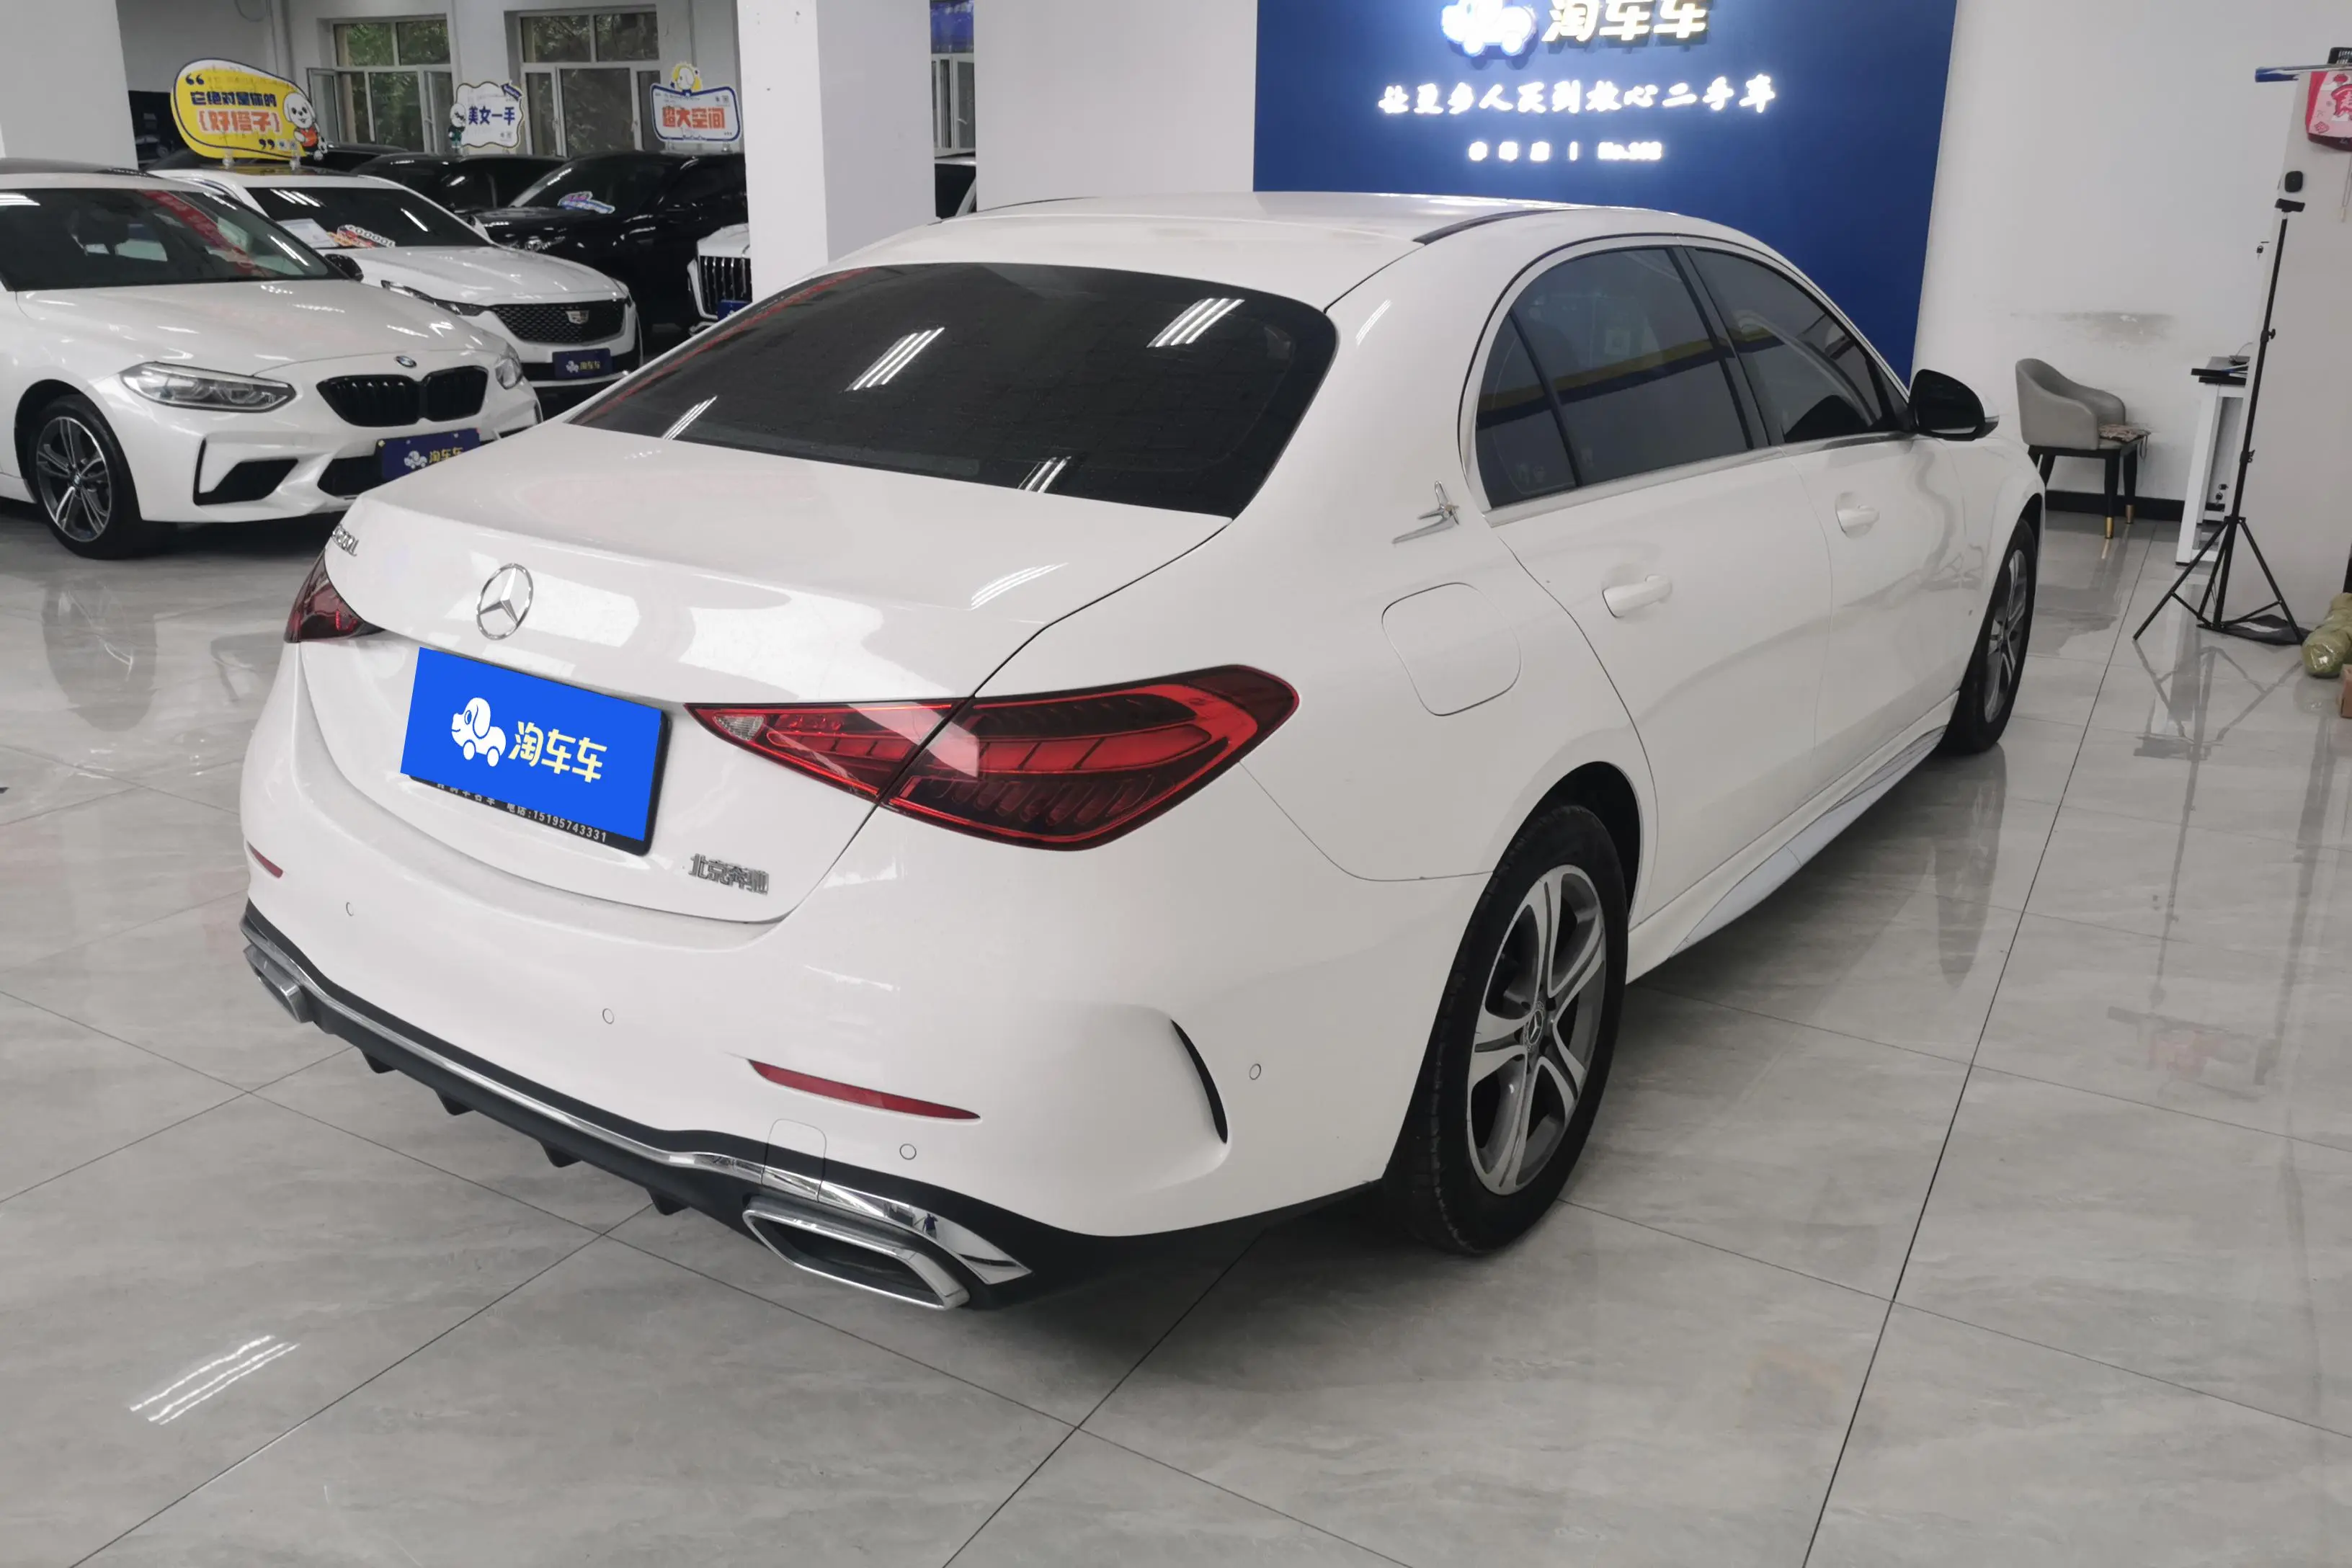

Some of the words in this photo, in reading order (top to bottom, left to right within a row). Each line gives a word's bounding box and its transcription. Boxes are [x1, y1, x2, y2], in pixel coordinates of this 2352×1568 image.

[1541, 0, 1707, 42] 淘车车
[468, 105, 515, 126] 美女一手
[662, 105, 725, 129] 超大空间
[688, 853, 770, 896] 北京奔驰
